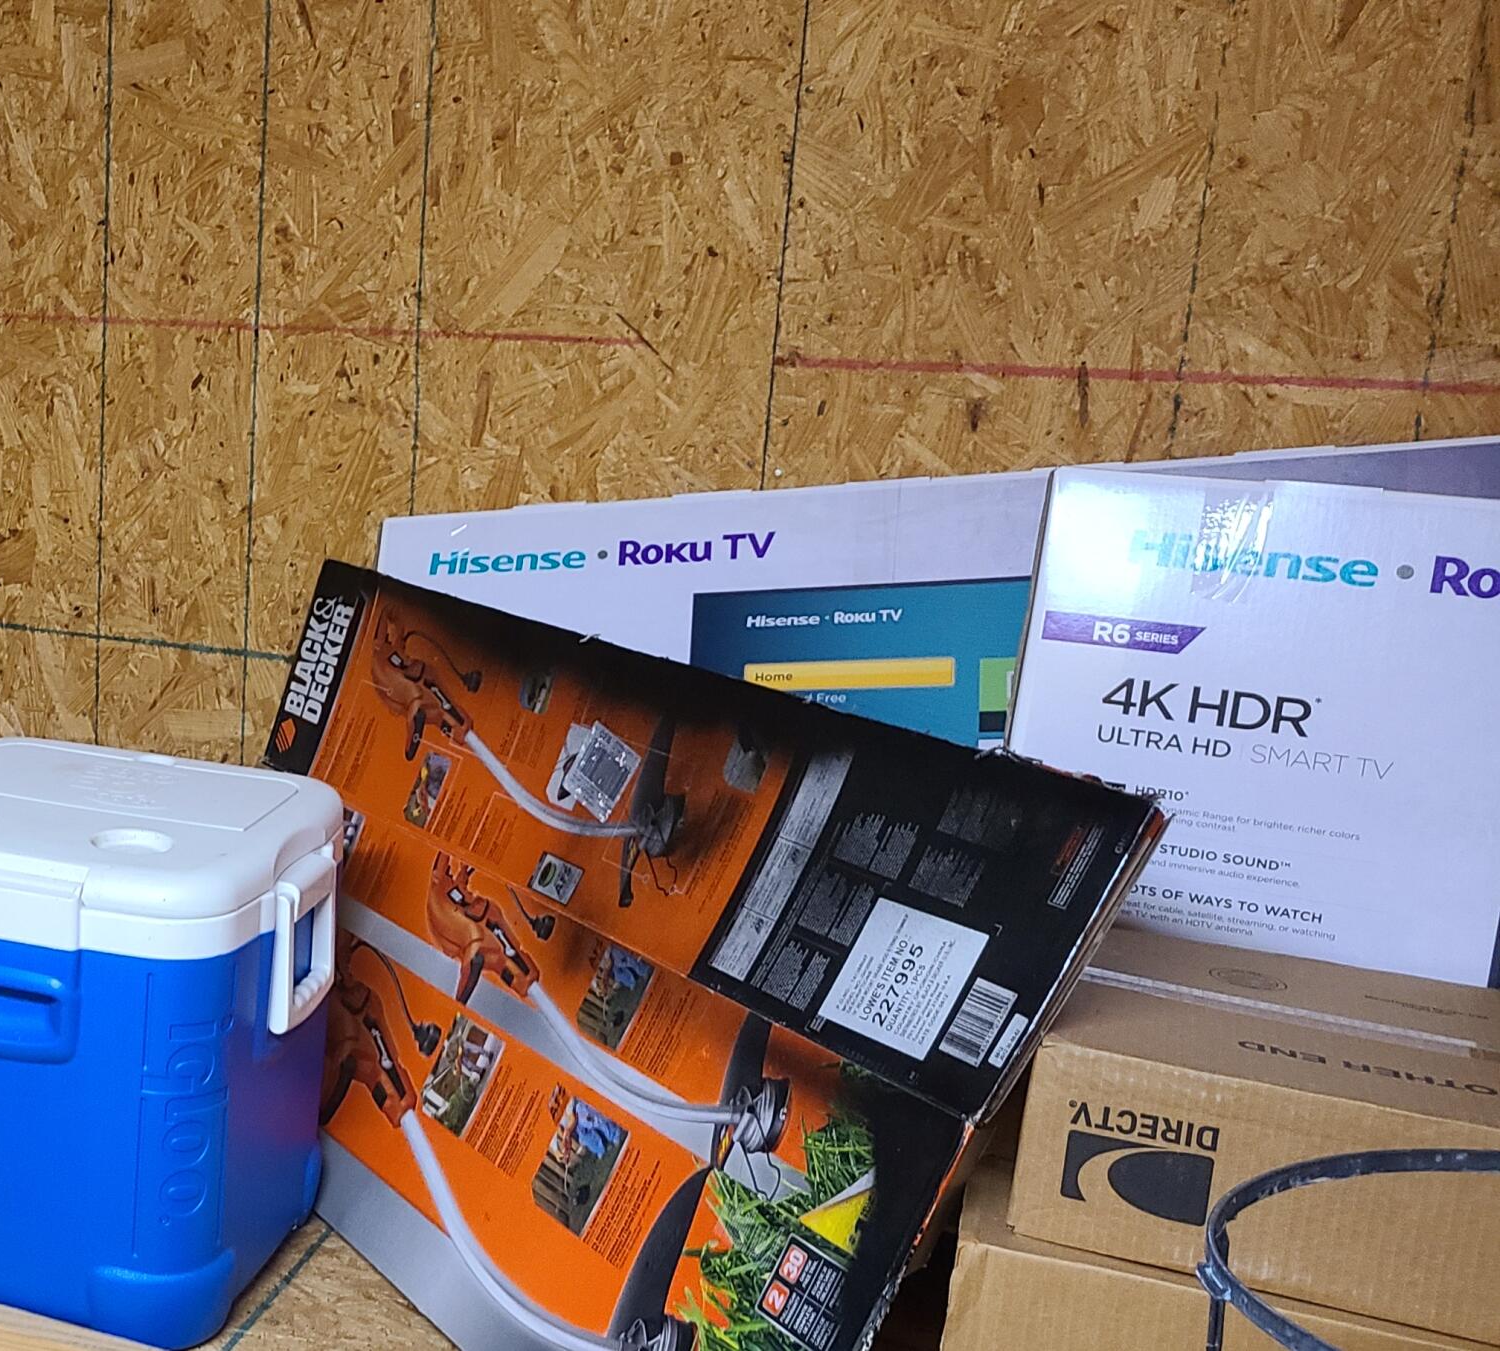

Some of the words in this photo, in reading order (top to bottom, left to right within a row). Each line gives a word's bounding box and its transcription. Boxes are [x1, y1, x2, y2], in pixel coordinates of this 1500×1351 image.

[428, 548, 587, 576] Hisense
[722, 531, 776, 561] TV
[1429, 555, 1500, 600] Ro
[746, 615, 821, 628] Hisense
[879, 608, 904, 622] TV
[1092, 621, 1131, 644] R6
[1134, 630, 1179, 646] SERIES
[300, 604, 355, 725] DECKER
[754, 671, 793, 682] Home
[816, 692, 847, 704] Free
[1101, 677, 1180, 721] 4K
[1097, 724, 1183, 753] ULTRA
[1191, 737, 1232, 758] HD
[1249, 743, 1350, 775] SMART
[1356, 757, 1395, 780] TV
[1202, 810, 1235, 823] Range
[1236, 814, 1252, 825] for
[1297, 824, 1327, 837] richer
[1328, 829, 1361, 841] colors
[1159, 843, 1218, 861] STUDIO
[1169, 861, 1216, 876] immersive
[1217, 868, 1245, 880] audio
[1130, 884, 1157, 897] OTS
[1162, 888, 1184, 901] OF
[1188, 892, 1233, 910] WAYS
[1238, 900, 1259, 914] TO
[1264, 904, 1323, 924] WATCH
[1135, 910, 1149, 919] TV
[1150, 911, 1170, 923] with
[1171, 916, 1184, 925] an
[1185, 917, 1214, 931] HDTV
[1143, 901, 1156, 911] for
[1278, 924, 1289, 932] or
[1291, 926, 1336, 941] watching
[858, 980, 886, 1021] LOWE'S
[879, 956, 900, 982] ITEM
[869, 942, 925, 1028] 227995
[908, 962, 927, 986] 1PCS
[1238, 1040, 1327, 1065] END
[1342, 1060, 1499, 1096] OTHER
[782, 1248, 805, 1279] 30
[767, 1287, 786, 1309] 2
